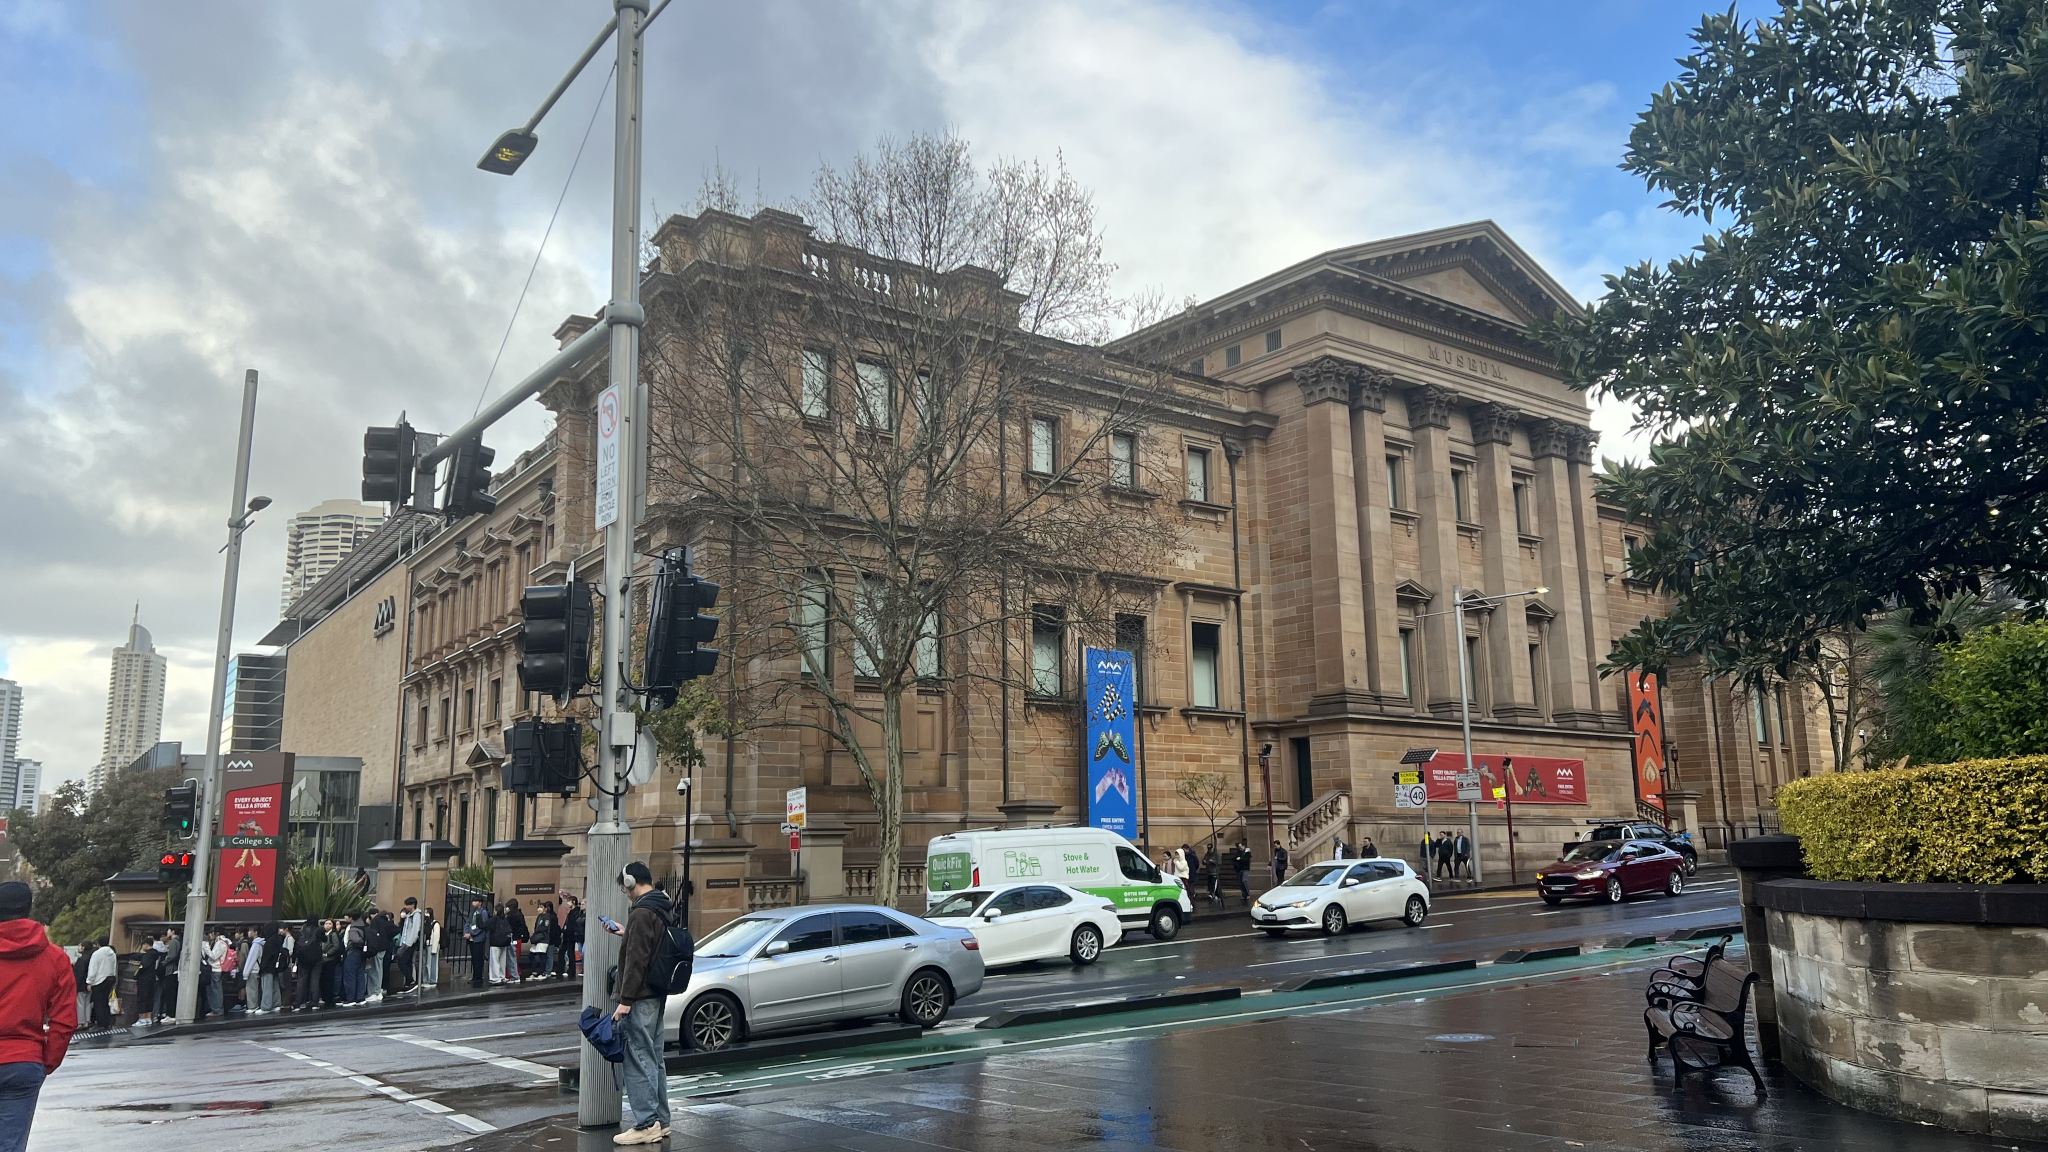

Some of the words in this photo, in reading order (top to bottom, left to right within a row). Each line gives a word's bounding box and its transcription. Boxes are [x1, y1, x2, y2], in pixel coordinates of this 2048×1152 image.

[603, 442, 615, 463] NO
[601, 461, 615, 478] LEFT
[600, 475, 616, 492] TURN
[598, 499, 615, 515] BICYCLE
[1413, 791, 1423, 801] 40
[232, 837, 262, 846] College
[932, 856, 962, 871] QuickFix
[1063, 853, 1083, 861] Stove
[1083, 852, 1089, 861] &
[1066, 866, 1079, 874] Hot
[1079, 865, 1100, 873] Water
